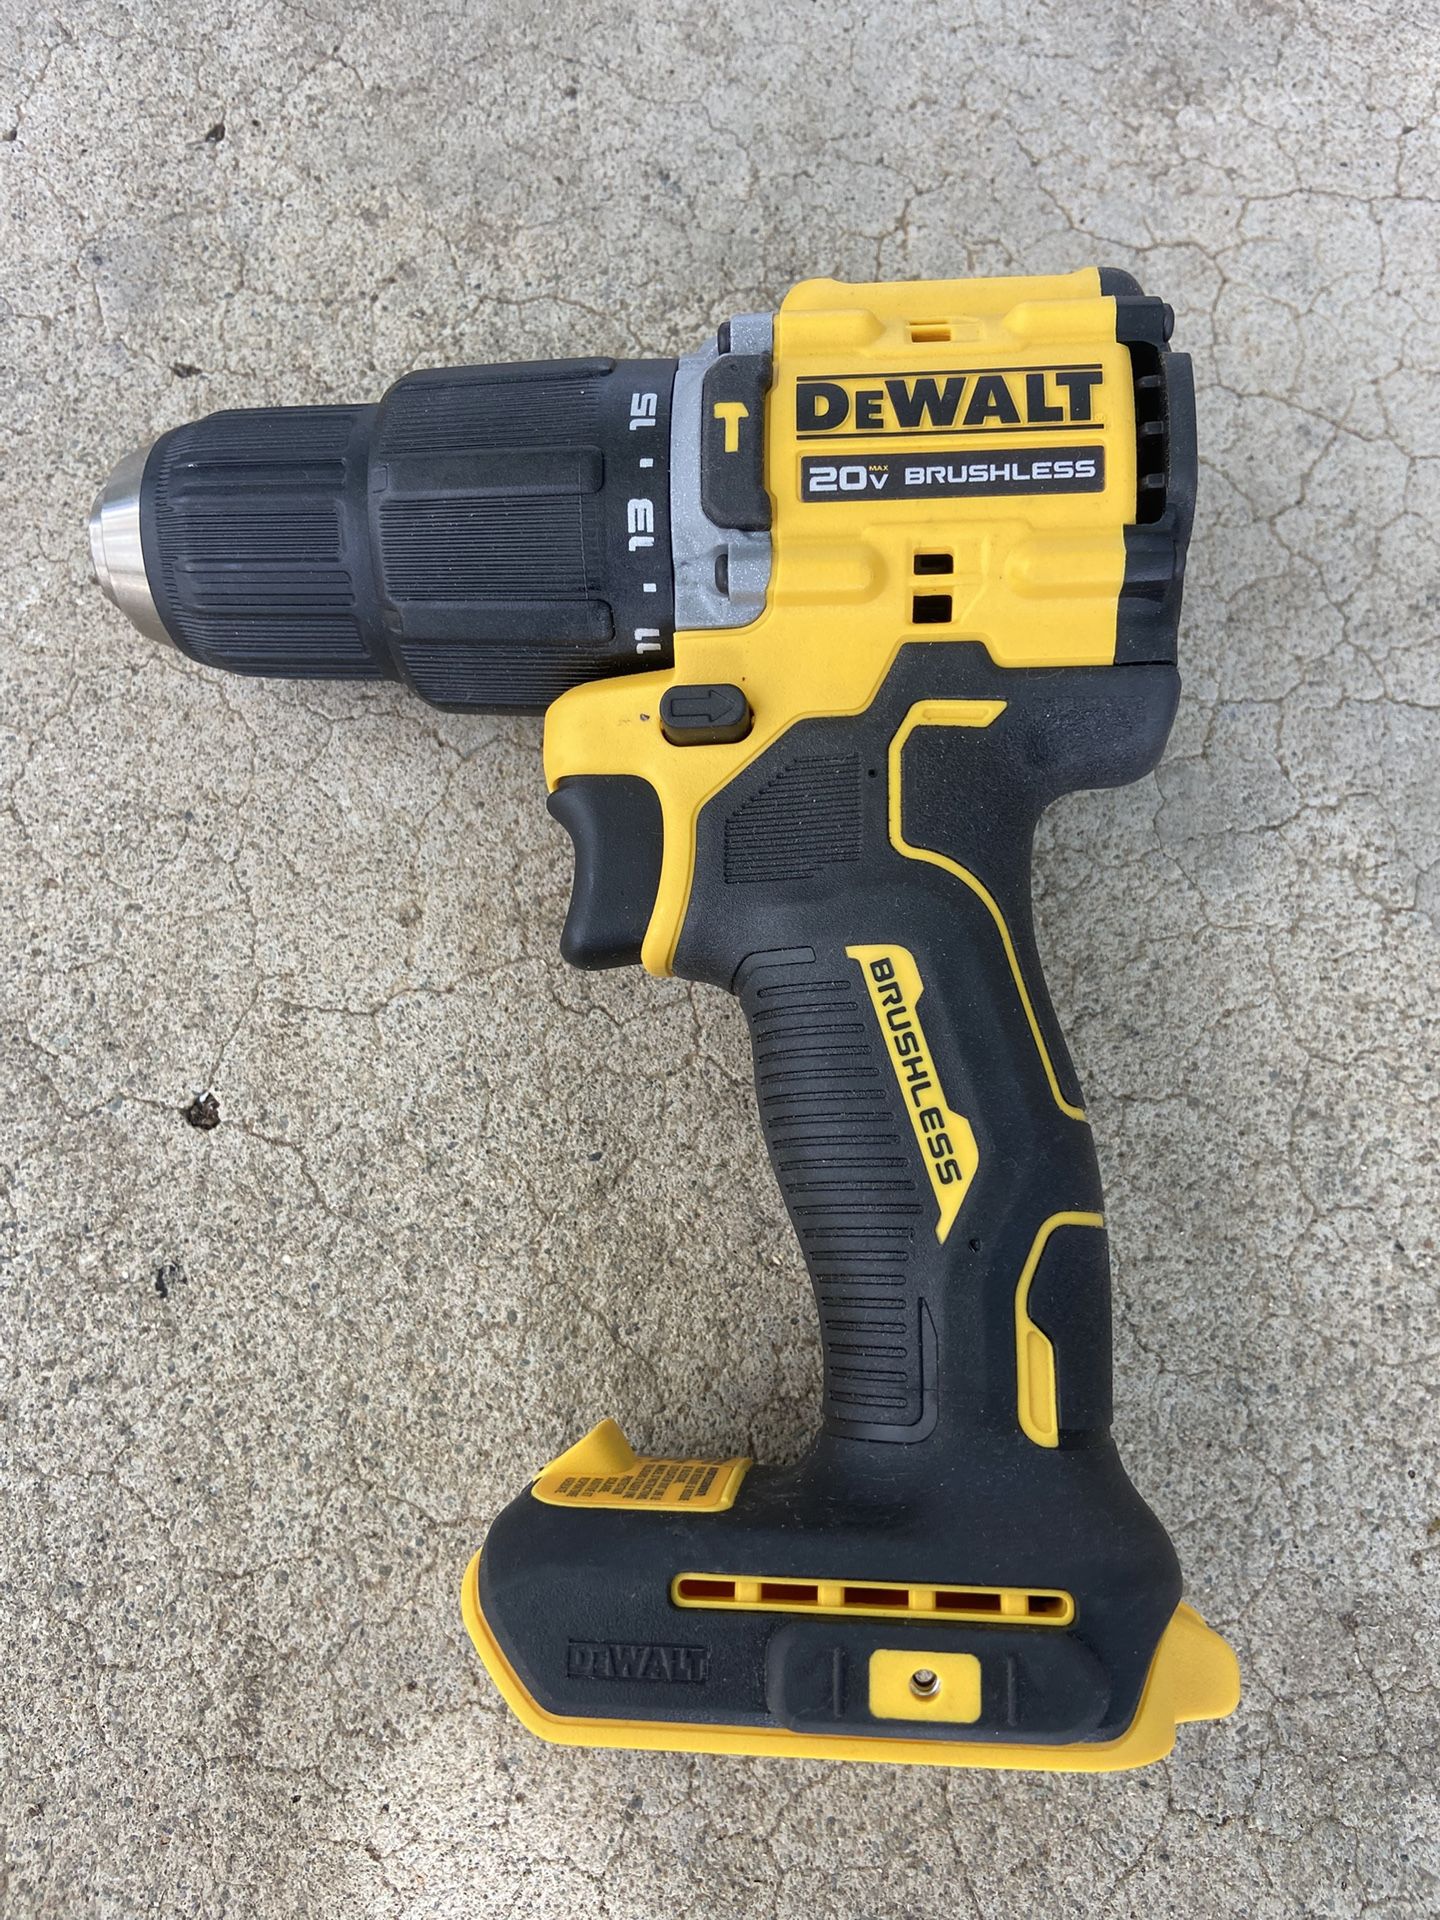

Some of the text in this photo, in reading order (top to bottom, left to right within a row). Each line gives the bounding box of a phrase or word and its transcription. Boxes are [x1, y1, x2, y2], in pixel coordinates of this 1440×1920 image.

[629, 393, 657, 431] 15
[868, 464, 889, 472] MAX
[904, 458, 1096, 486] BRUSHLESS
[627, 498, 655, 552] 13
[635, 627, 660, 654] 11
[870, 957, 962, 1186] BRUSHLESS
